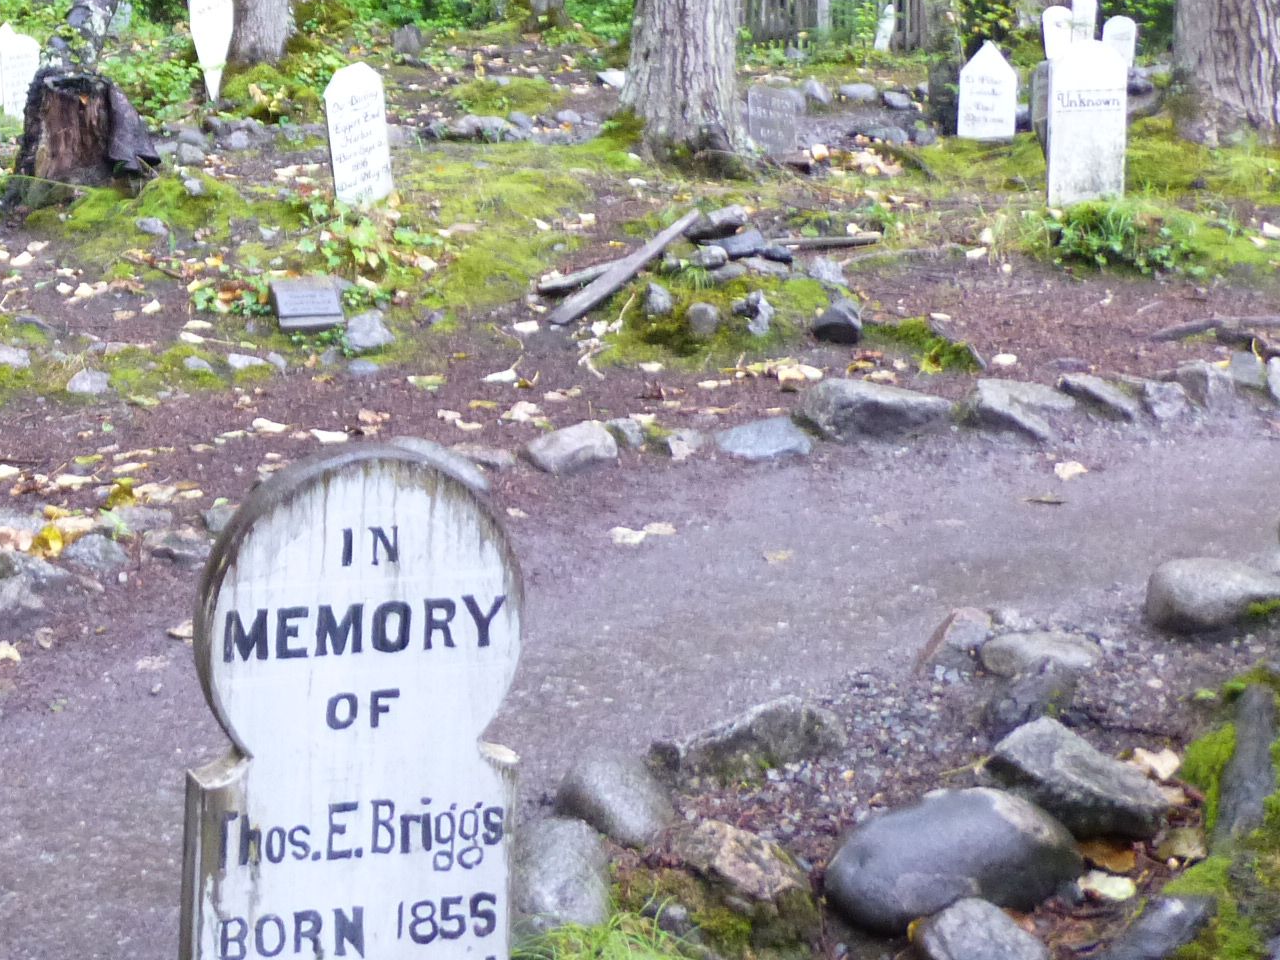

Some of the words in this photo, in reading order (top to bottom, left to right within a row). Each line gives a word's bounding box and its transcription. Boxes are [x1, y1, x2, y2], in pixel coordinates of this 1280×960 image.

[1056, 92, 1121, 109] Unknown
[340, 525, 400, 567] IN
[222, 594, 507, 664] MEMORY
[325, 687, 401, 730] OF
[219, 905, 366, 960] BORN
[396, 891, 498, 945] 1855
